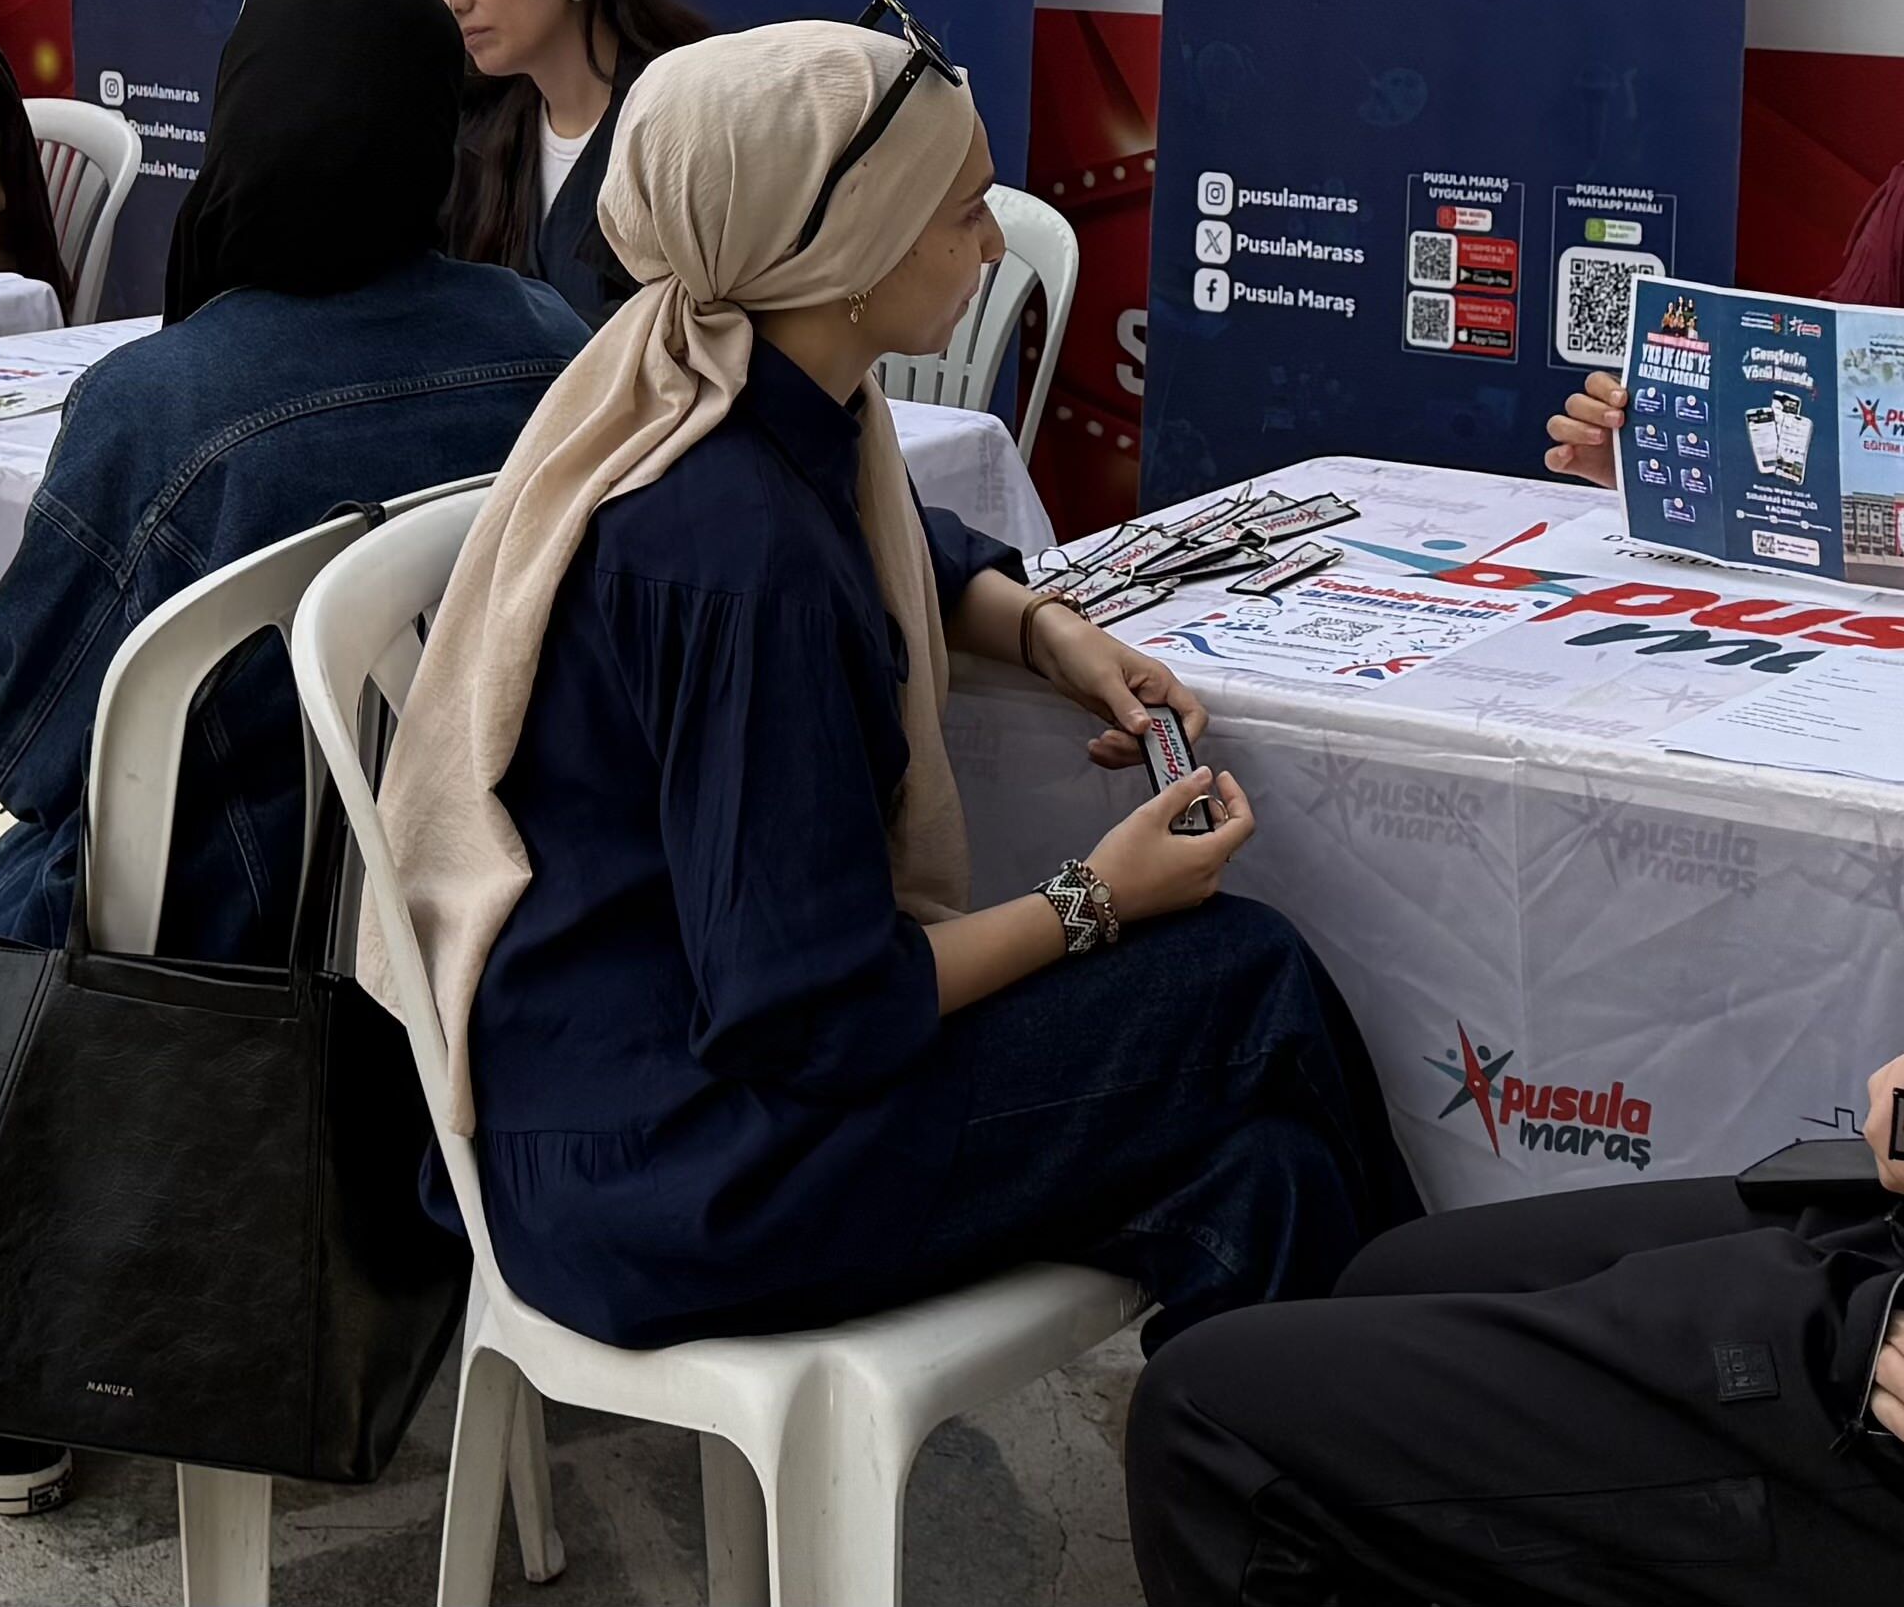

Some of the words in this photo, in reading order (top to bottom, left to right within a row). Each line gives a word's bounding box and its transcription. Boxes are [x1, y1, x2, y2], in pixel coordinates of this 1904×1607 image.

[127, 83, 200, 104] pusulamaras
[138, 160, 166, 177] usula
[167, 162, 200, 181] Mara
[1423, 171, 1467, 187] PUSULA
[1468, 175, 1509, 192] MARAŞ
[1238, 186, 1359, 214] pusulamaras
[1576, 184, 1616, 198] PUSULA
[1236, 234, 1365, 265] PusulaMarass
[1232, 281, 1294, 307] Pusula
[1297, 287, 1356, 319] Maraş
[1619, 815, 1758, 867] pusula
[1498, 1074, 1653, 1137] pusula
[1518, 1119, 1653, 1173] maraş
[86, 1380, 134, 1398] MANUKA
